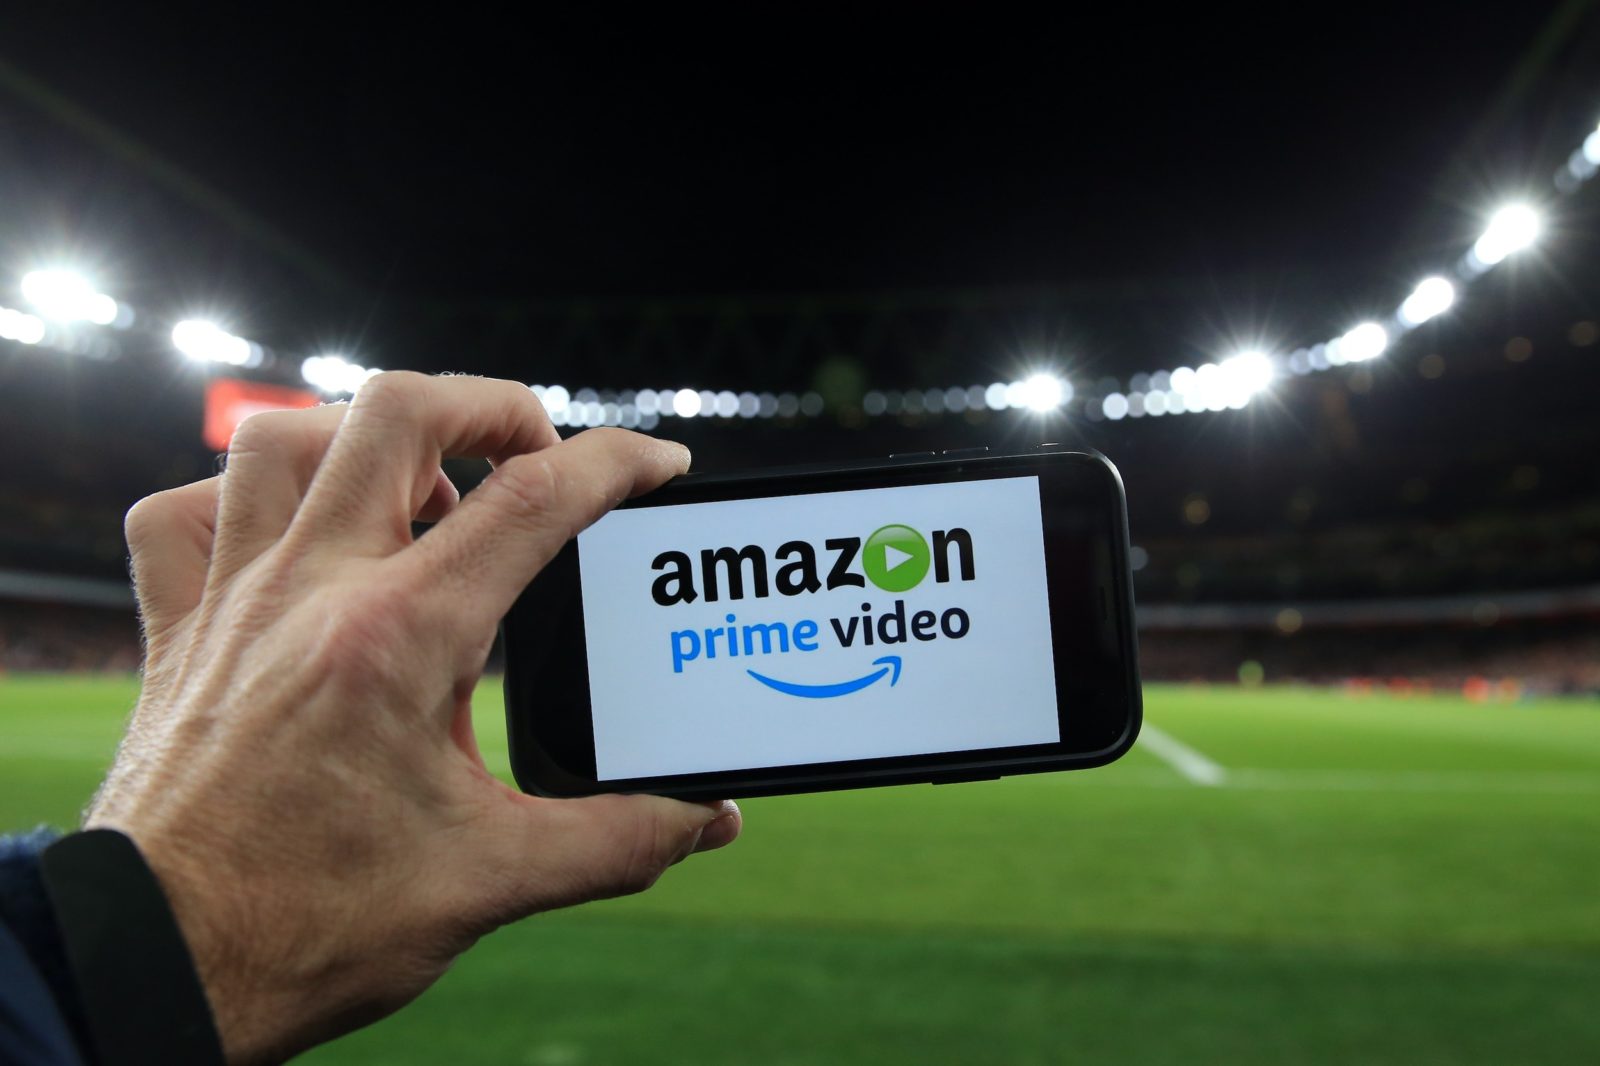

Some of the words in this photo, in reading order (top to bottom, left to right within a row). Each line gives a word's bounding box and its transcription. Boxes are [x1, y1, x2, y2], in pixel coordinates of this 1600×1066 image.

[651, 524, 975, 606] amazon
[671, 613, 820, 673] prime
[830, 600, 970, 647] video
